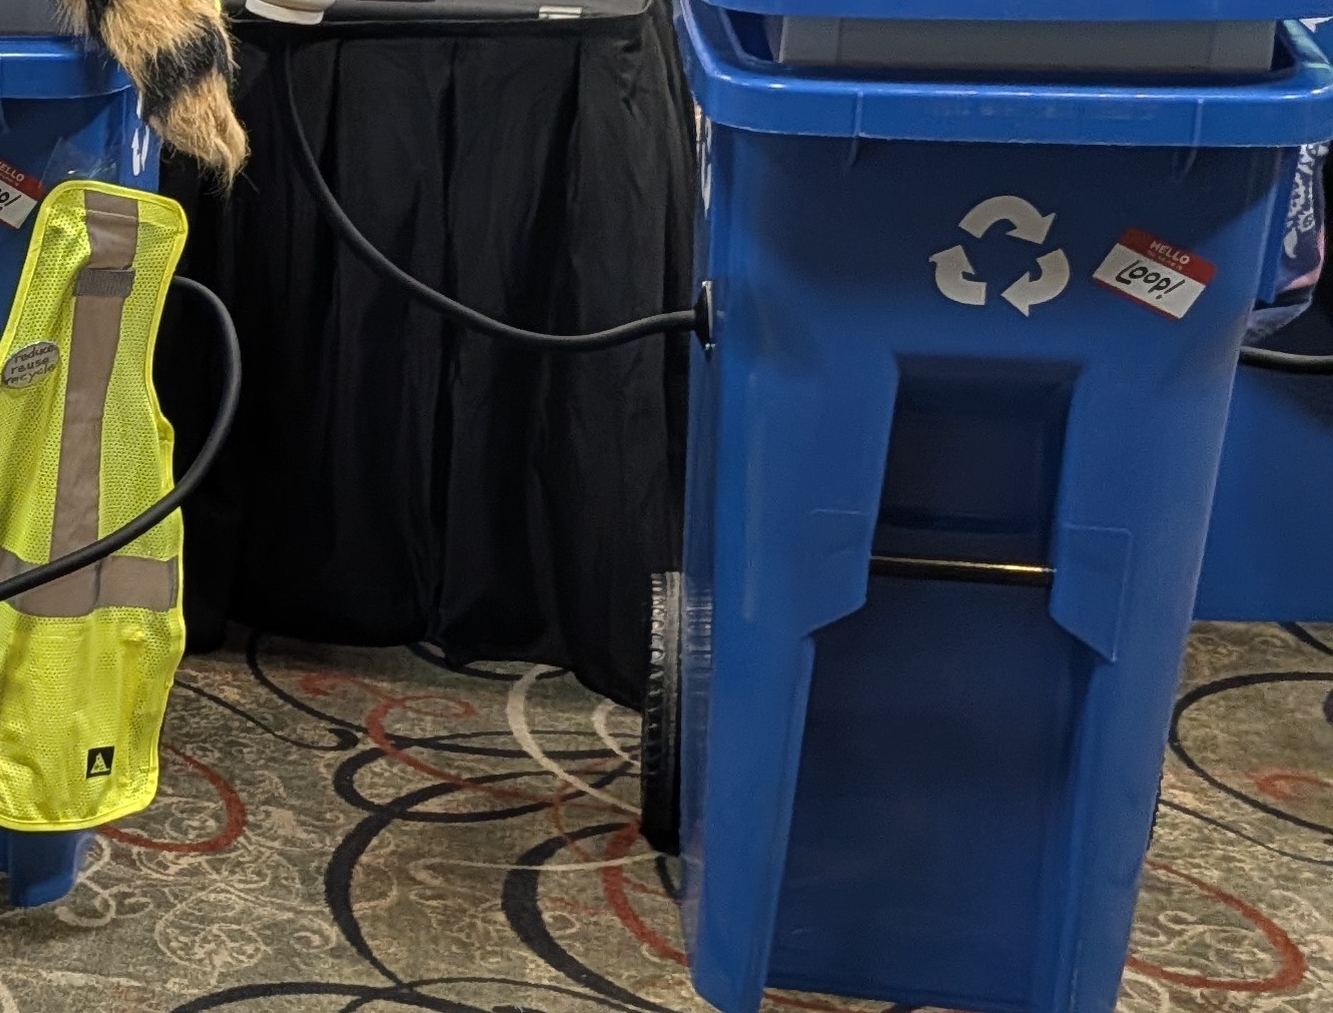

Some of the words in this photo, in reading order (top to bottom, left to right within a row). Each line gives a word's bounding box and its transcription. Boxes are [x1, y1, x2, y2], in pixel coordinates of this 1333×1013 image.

[1149, 240, 1191, 265] HELLO
[1115, 259, 1186, 300] Loop!
[14, 344, 57, 364] reduce
[3, 363, 55, 385] recycle
[10, 357, 50, 375] reuse
